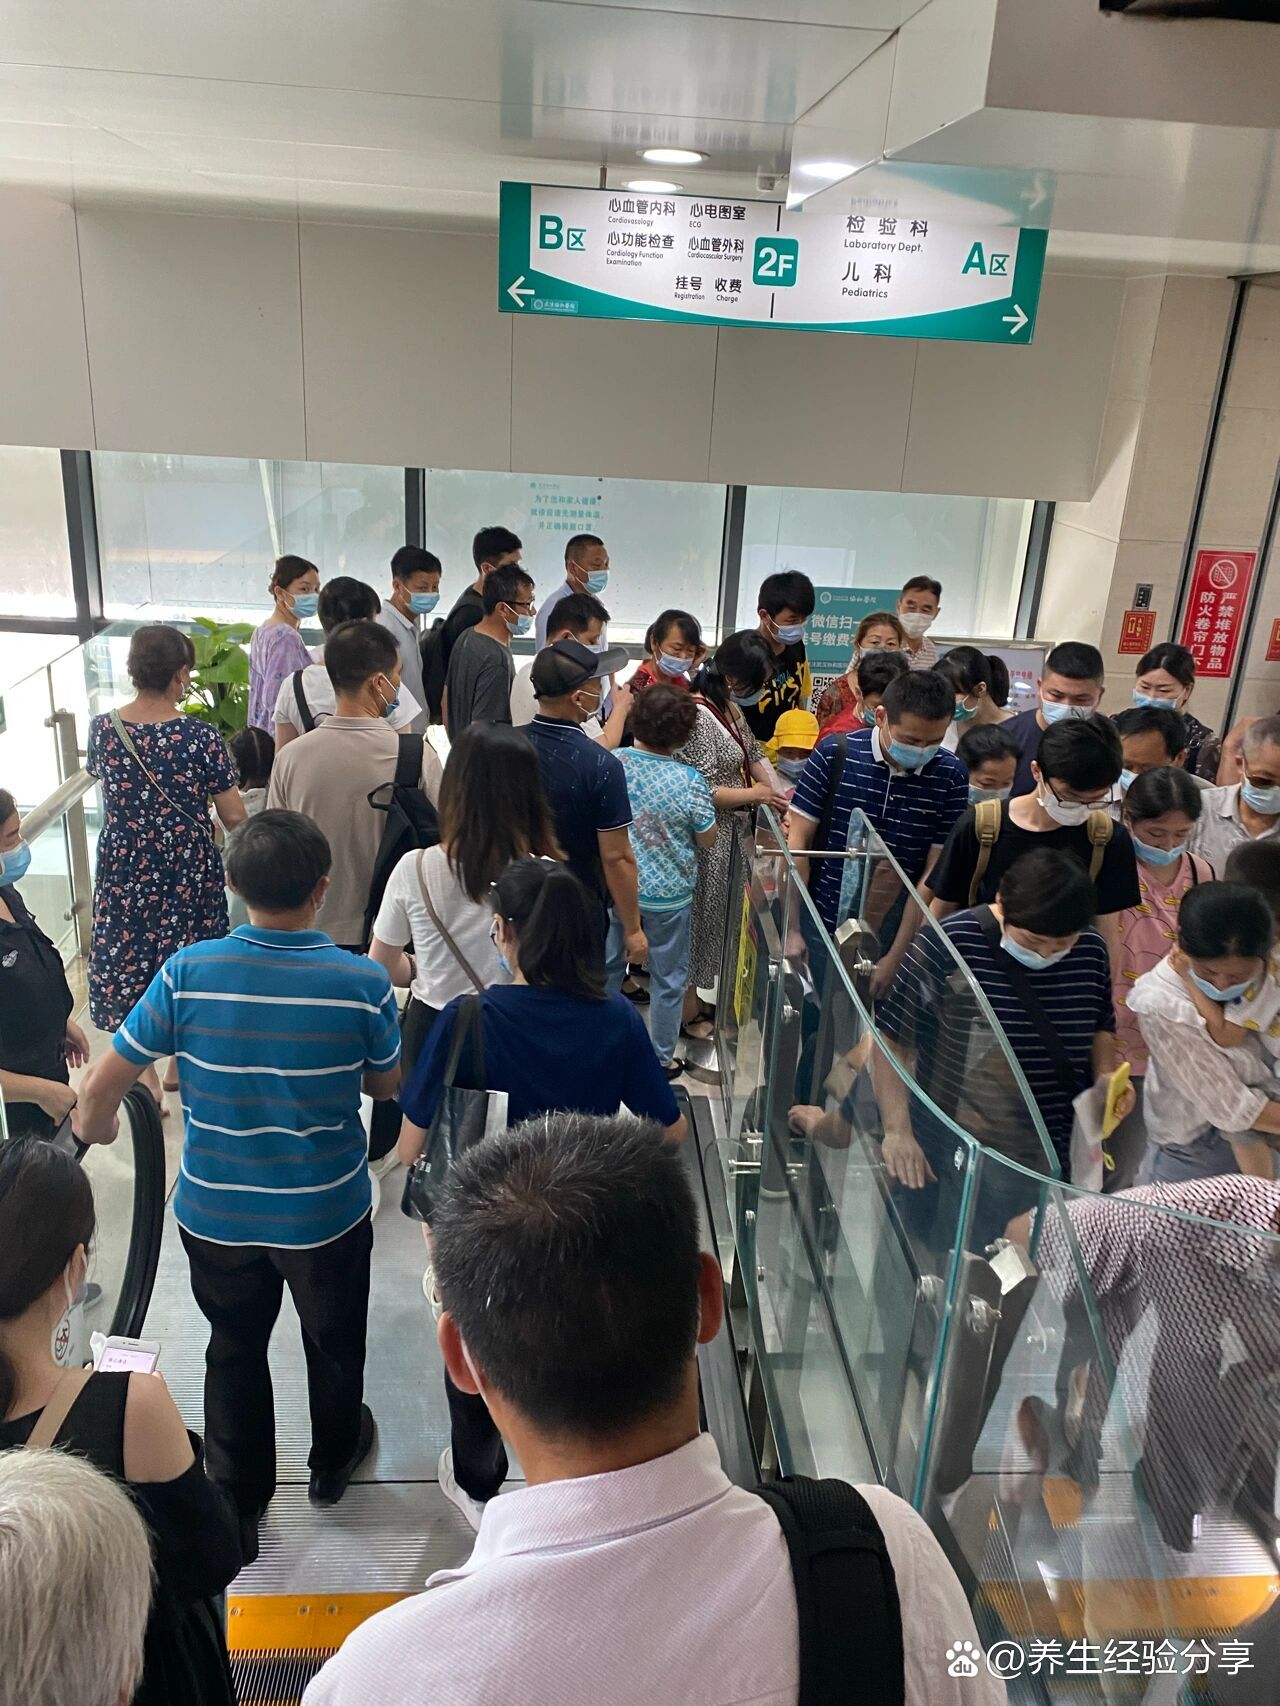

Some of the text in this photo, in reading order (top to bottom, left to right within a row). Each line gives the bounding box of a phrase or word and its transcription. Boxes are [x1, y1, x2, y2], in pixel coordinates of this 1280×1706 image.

[608, 198, 676, 216] 心血管内科
[690, 203, 746, 220] 心电图室
[539, 214, 587, 251] B区
[846, 215, 928, 238] 检验科
[607, 231, 675, 249] 心功能检查
[688, 236, 744, 253] 心血管外科
[844, 238, 924, 253] Laboratory Dept.
[606, 249, 664, 259] Cardiology Function
[606, 258, 642, 266] Examination
[724, 254, 743, 262] Surgery
[757, 247, 794, 277] 2F
[962, 241, 1010, 275] A区
[842, 261, 892, 283] 儿科
[675, 275, 742, 293] 挂号 收费
[841, 287, 888, 299] Pediatrics
[674, 292, 738, 303] Registration Charge
[1206, 592, 1238, 670] 严禁堆放物品
